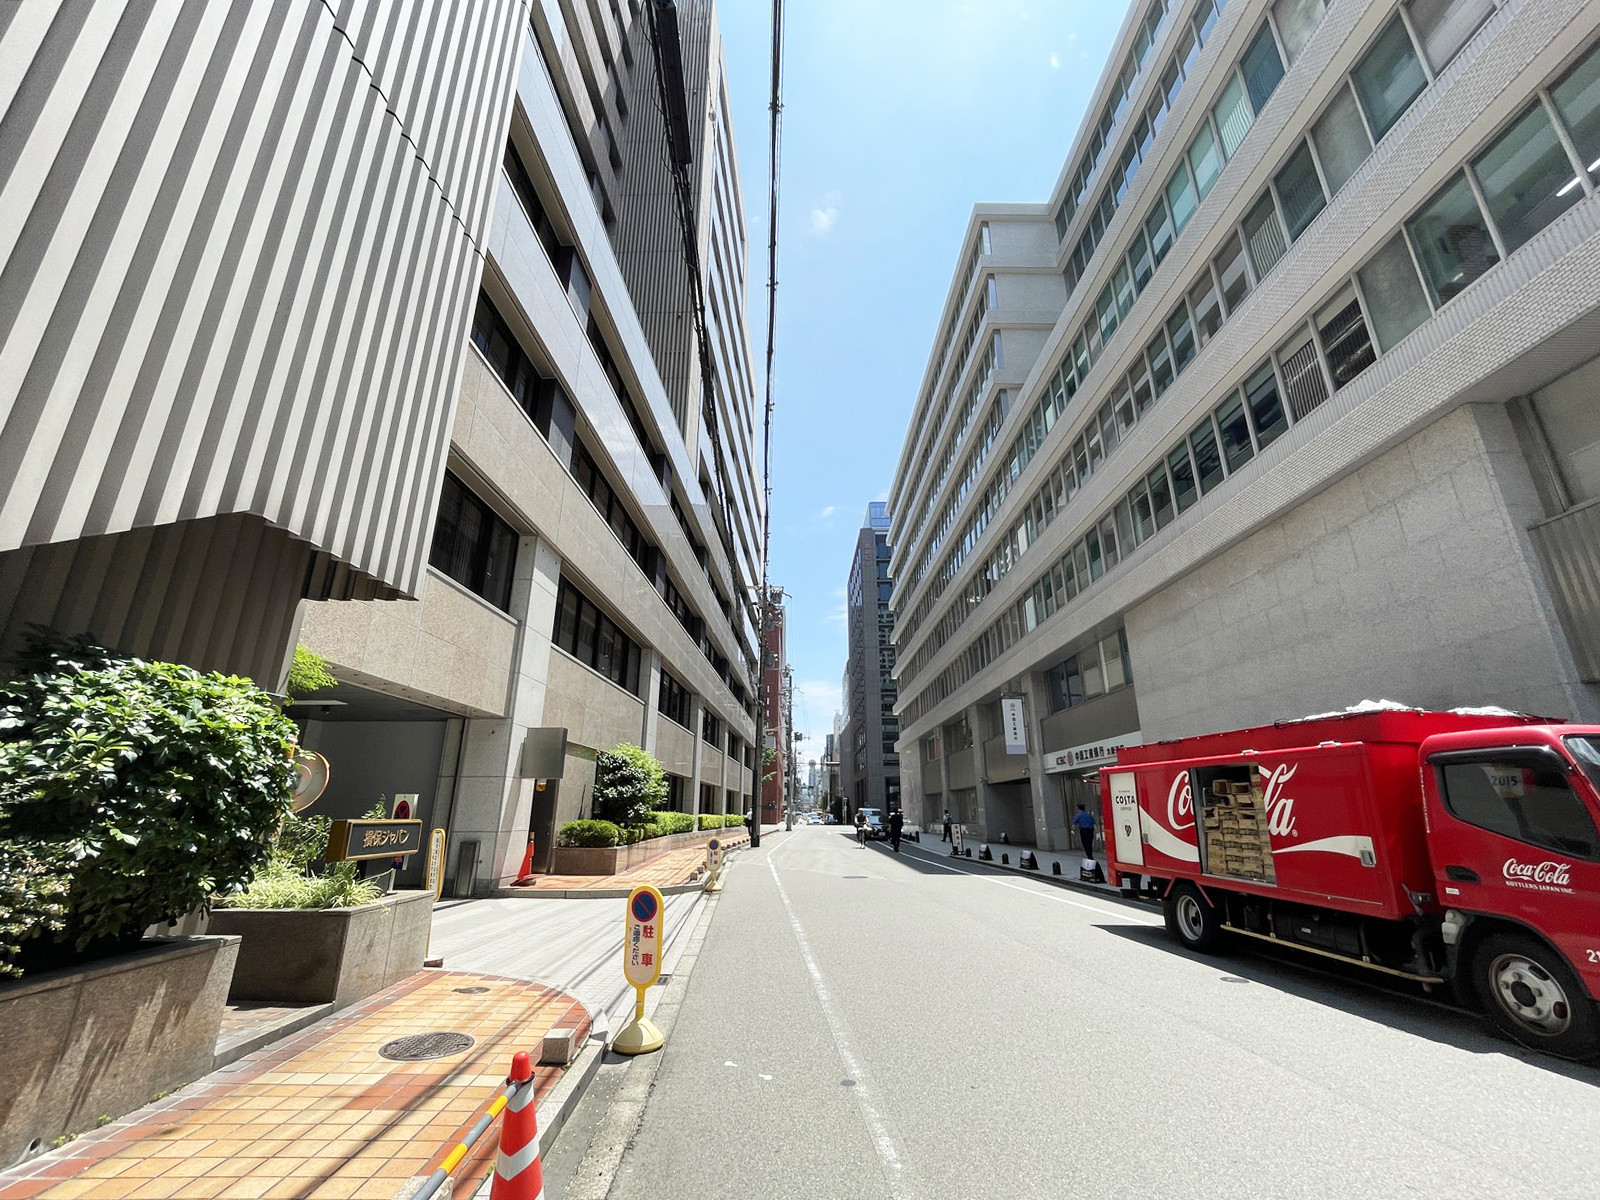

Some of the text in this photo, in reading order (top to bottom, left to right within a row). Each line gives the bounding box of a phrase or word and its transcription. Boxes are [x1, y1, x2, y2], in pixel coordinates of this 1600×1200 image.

[1115, 795, 1136, 805] COSTA
[363, 829, 410, 848] 損保ジャパン
